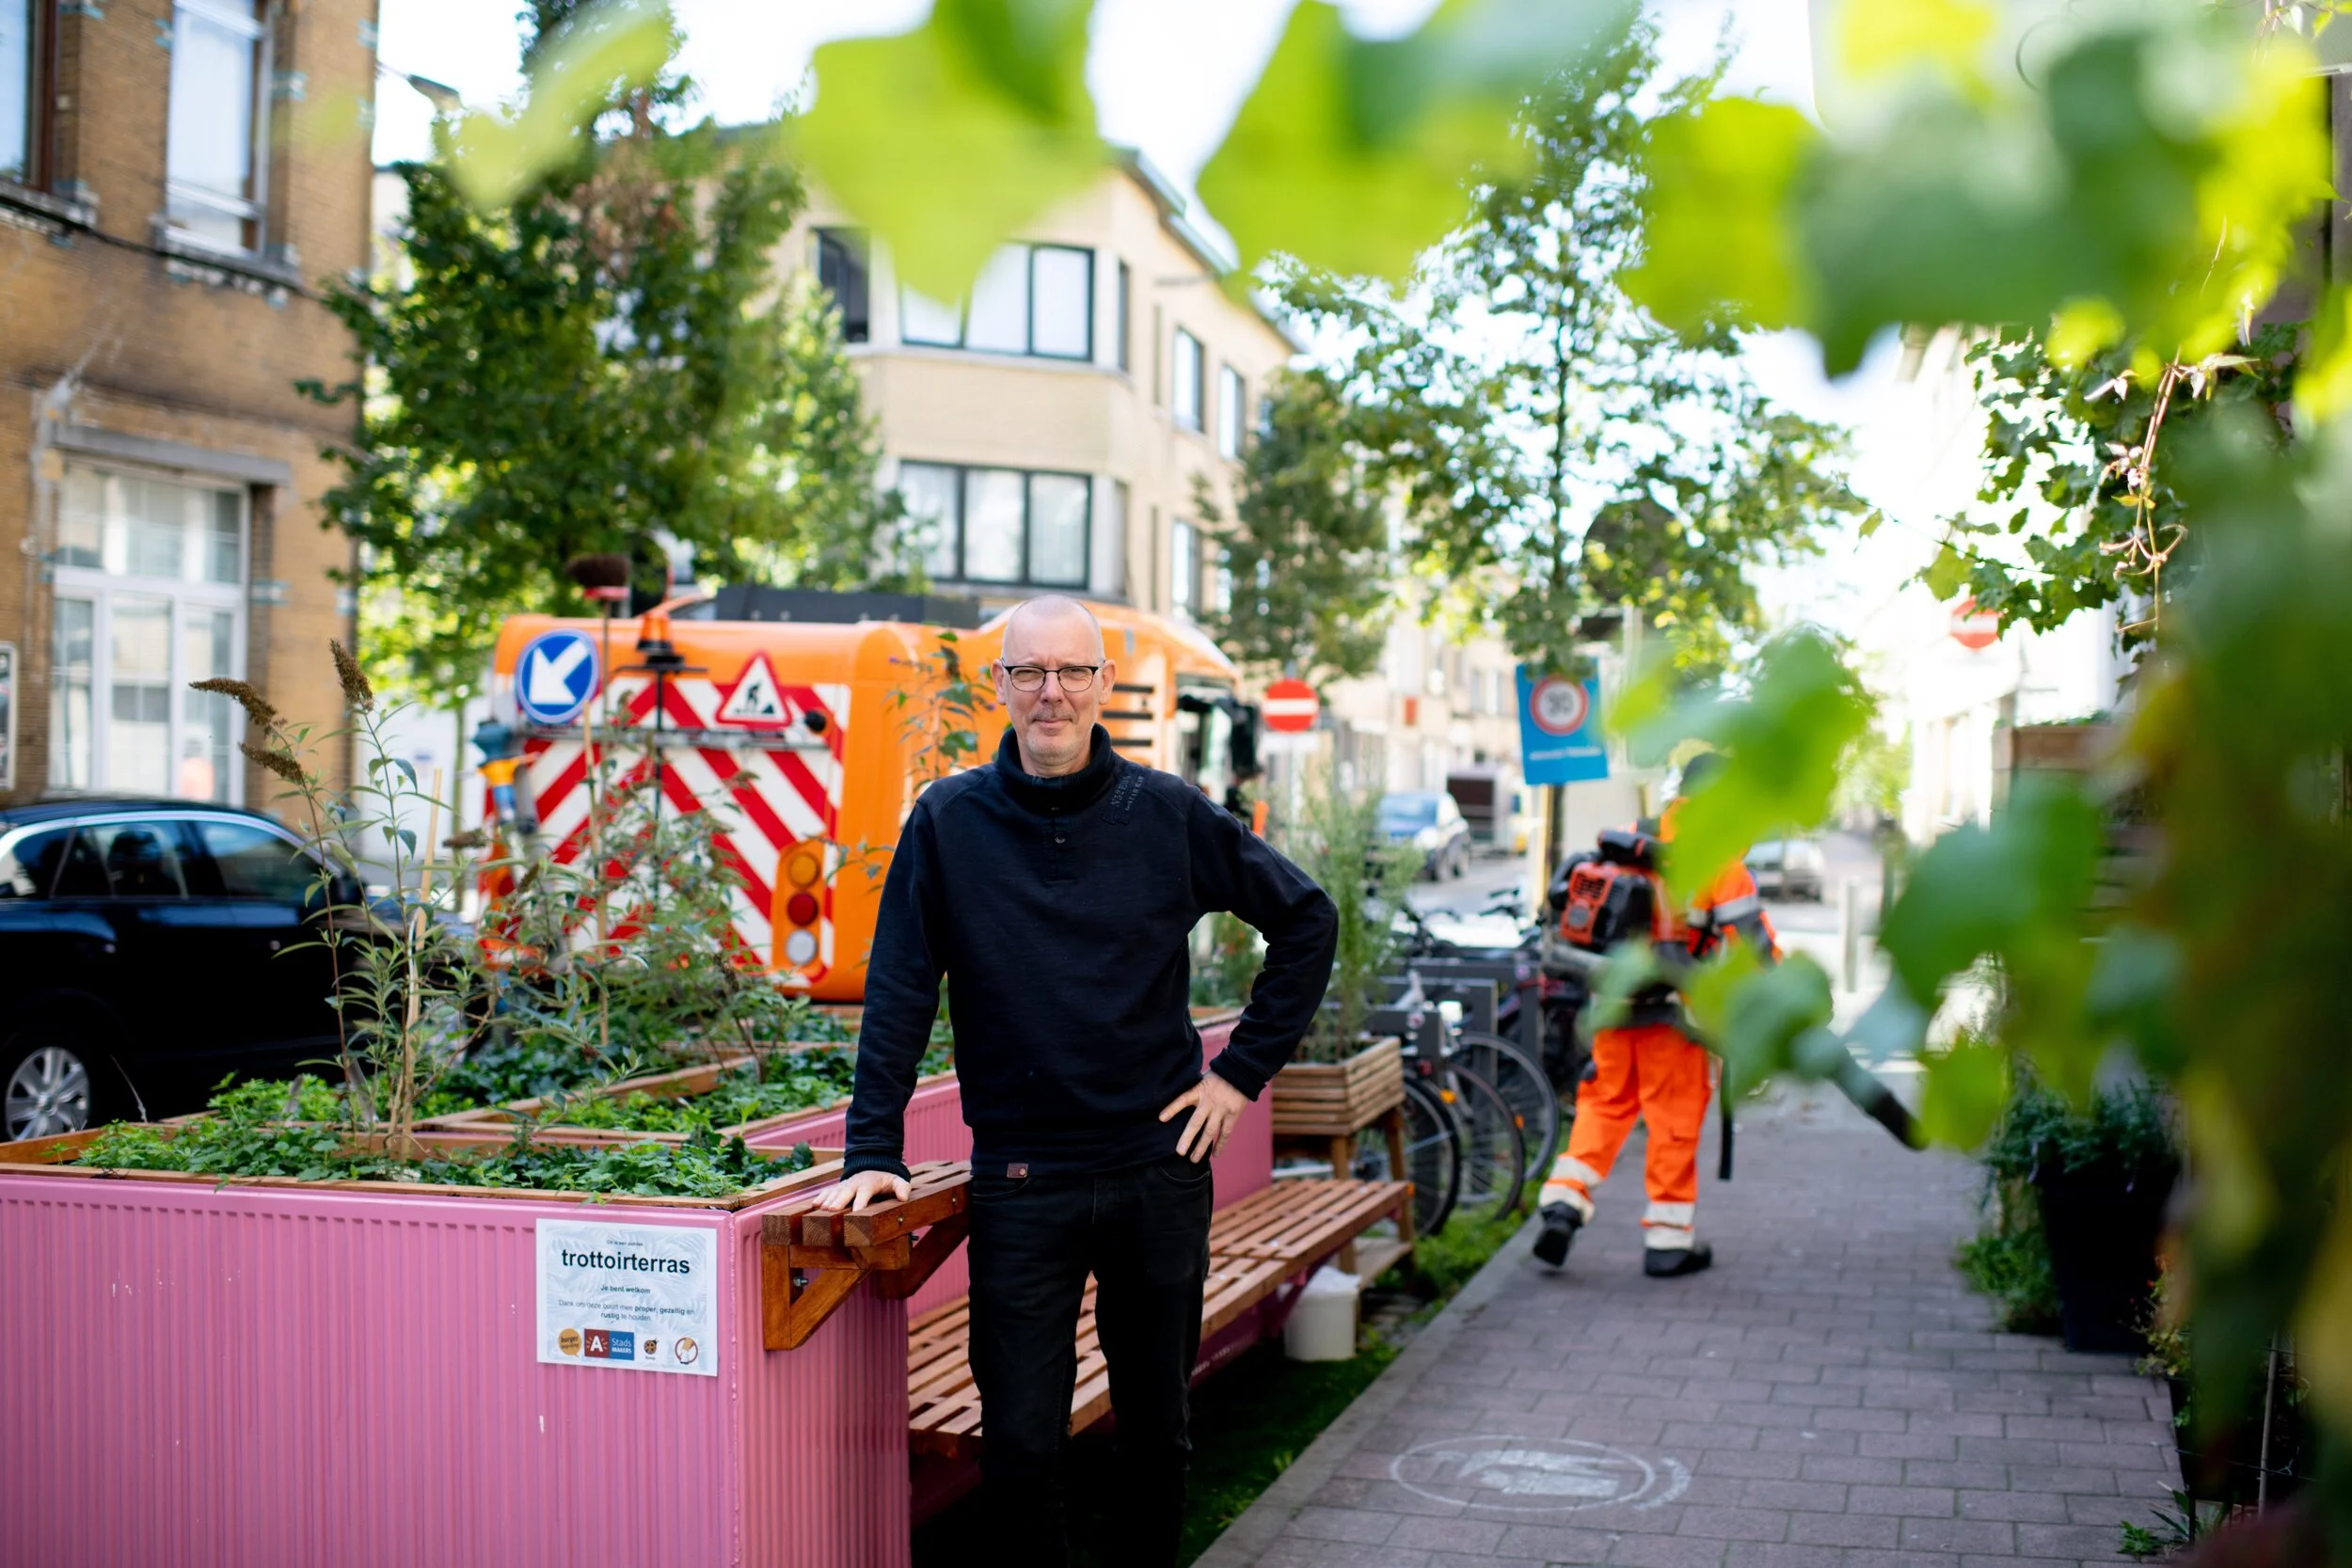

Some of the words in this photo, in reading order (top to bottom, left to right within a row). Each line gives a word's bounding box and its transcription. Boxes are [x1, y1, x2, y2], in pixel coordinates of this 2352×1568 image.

[562, 1248, 691, 1275] trottoirterras
[626, 1286, 651, 1294] welkom
[587, 1301, 601, 1309] deze
[660, 1307, 685, 1316] gezellig
[601, 1312, 619, 1321] rustig
[590, 1335, 604, 1353] A
[612, 1338, 631, 1348] Stads
[612, 1346, 632, 1354] MAKERS
